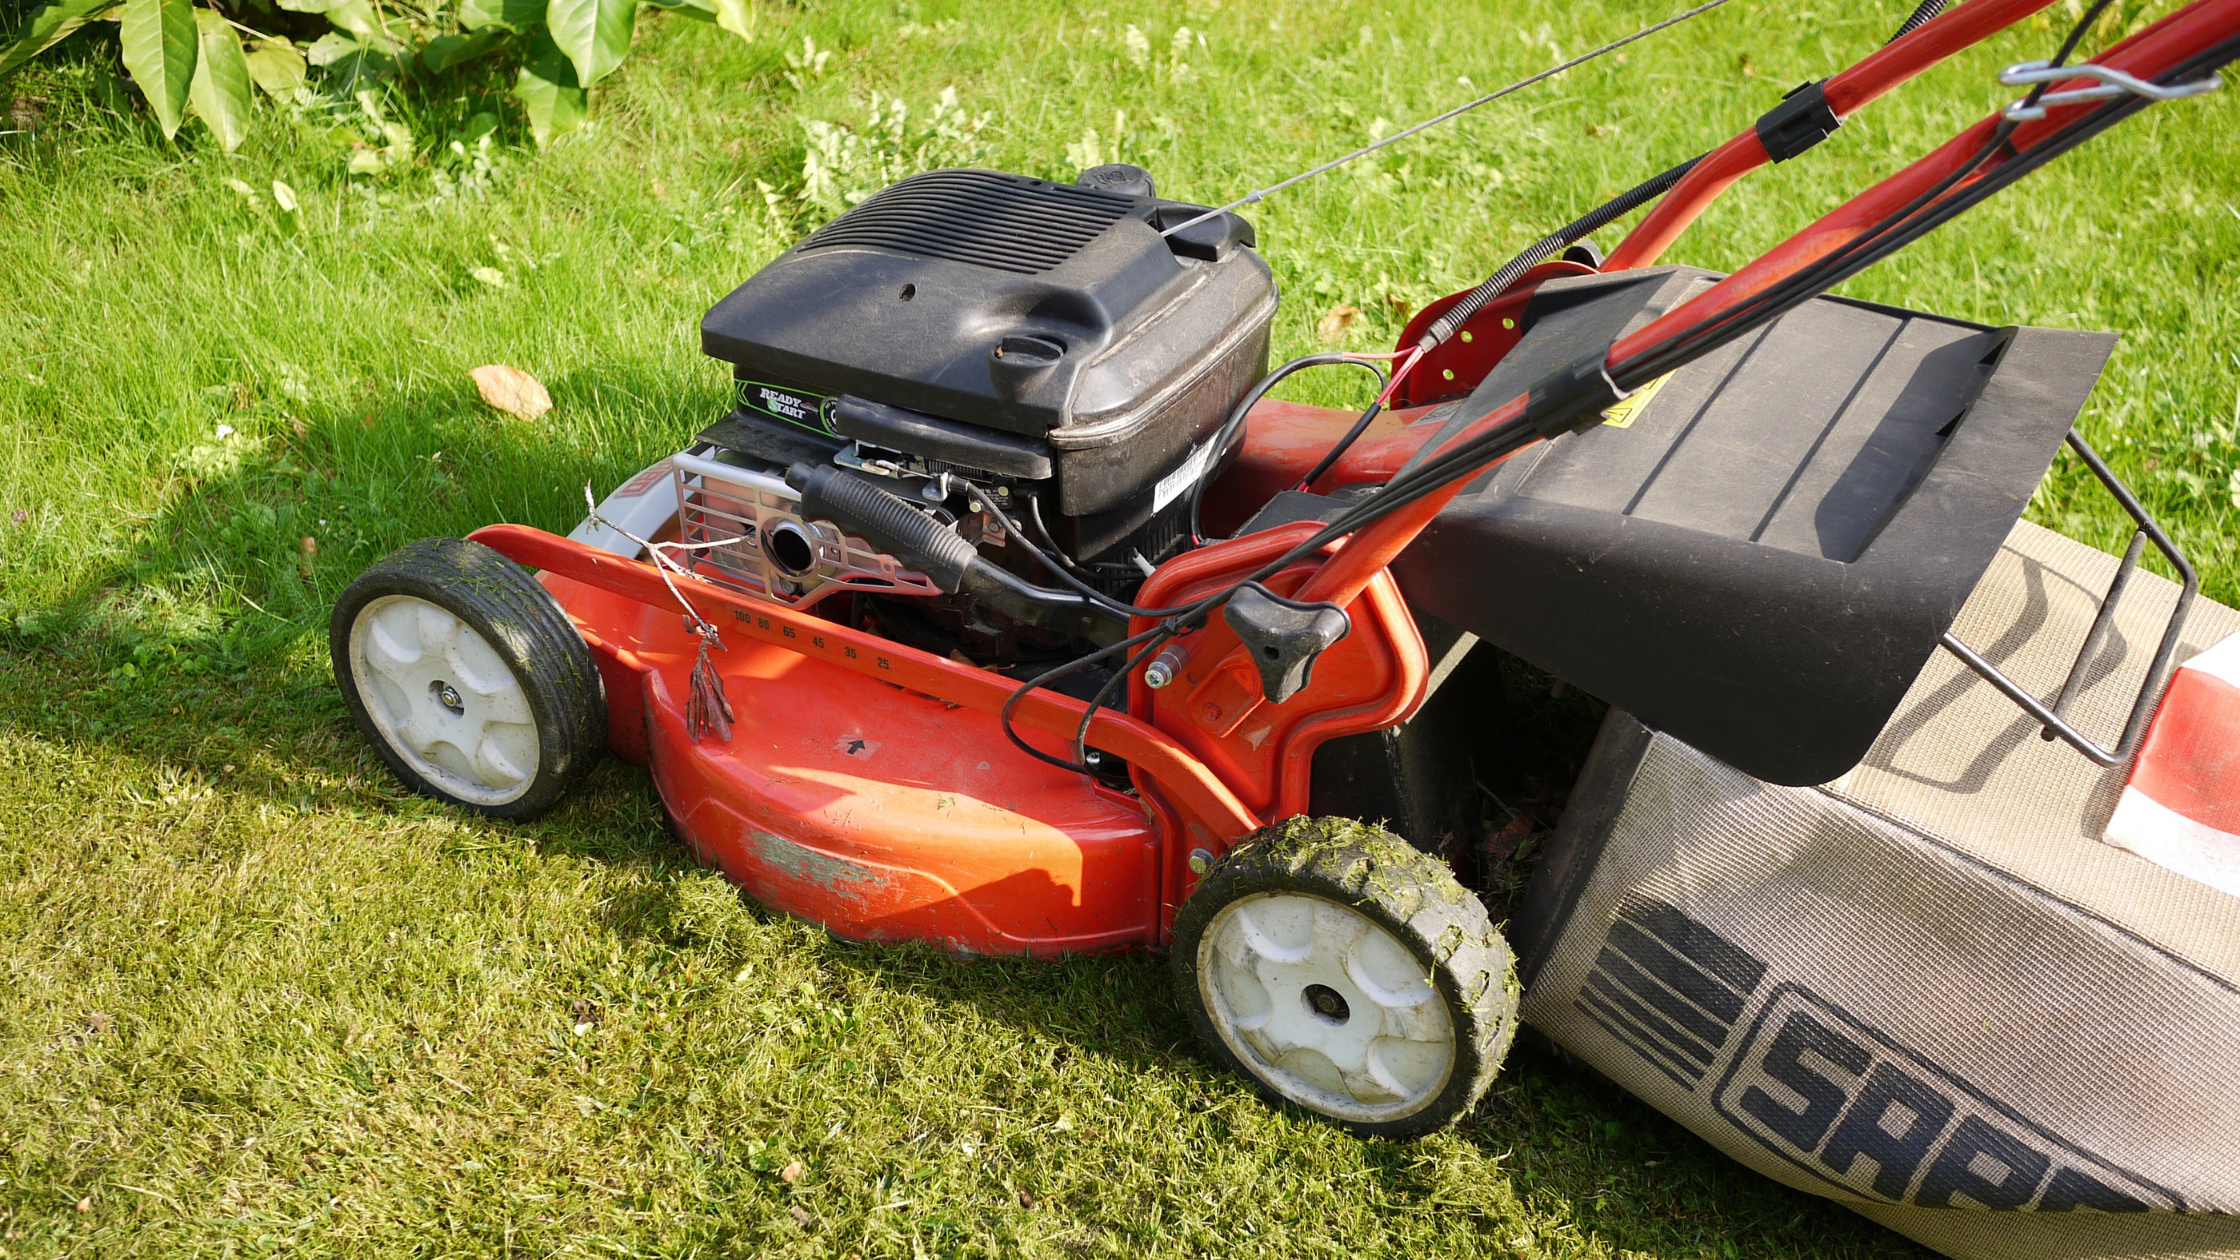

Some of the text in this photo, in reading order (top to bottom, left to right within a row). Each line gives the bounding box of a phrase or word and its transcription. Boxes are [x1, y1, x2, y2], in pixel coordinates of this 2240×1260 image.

[759, 387, 802, 408] READY
[767, 400, 807, 420] START
[734, 610, 890, 670] 100 80 65 45 35 25
